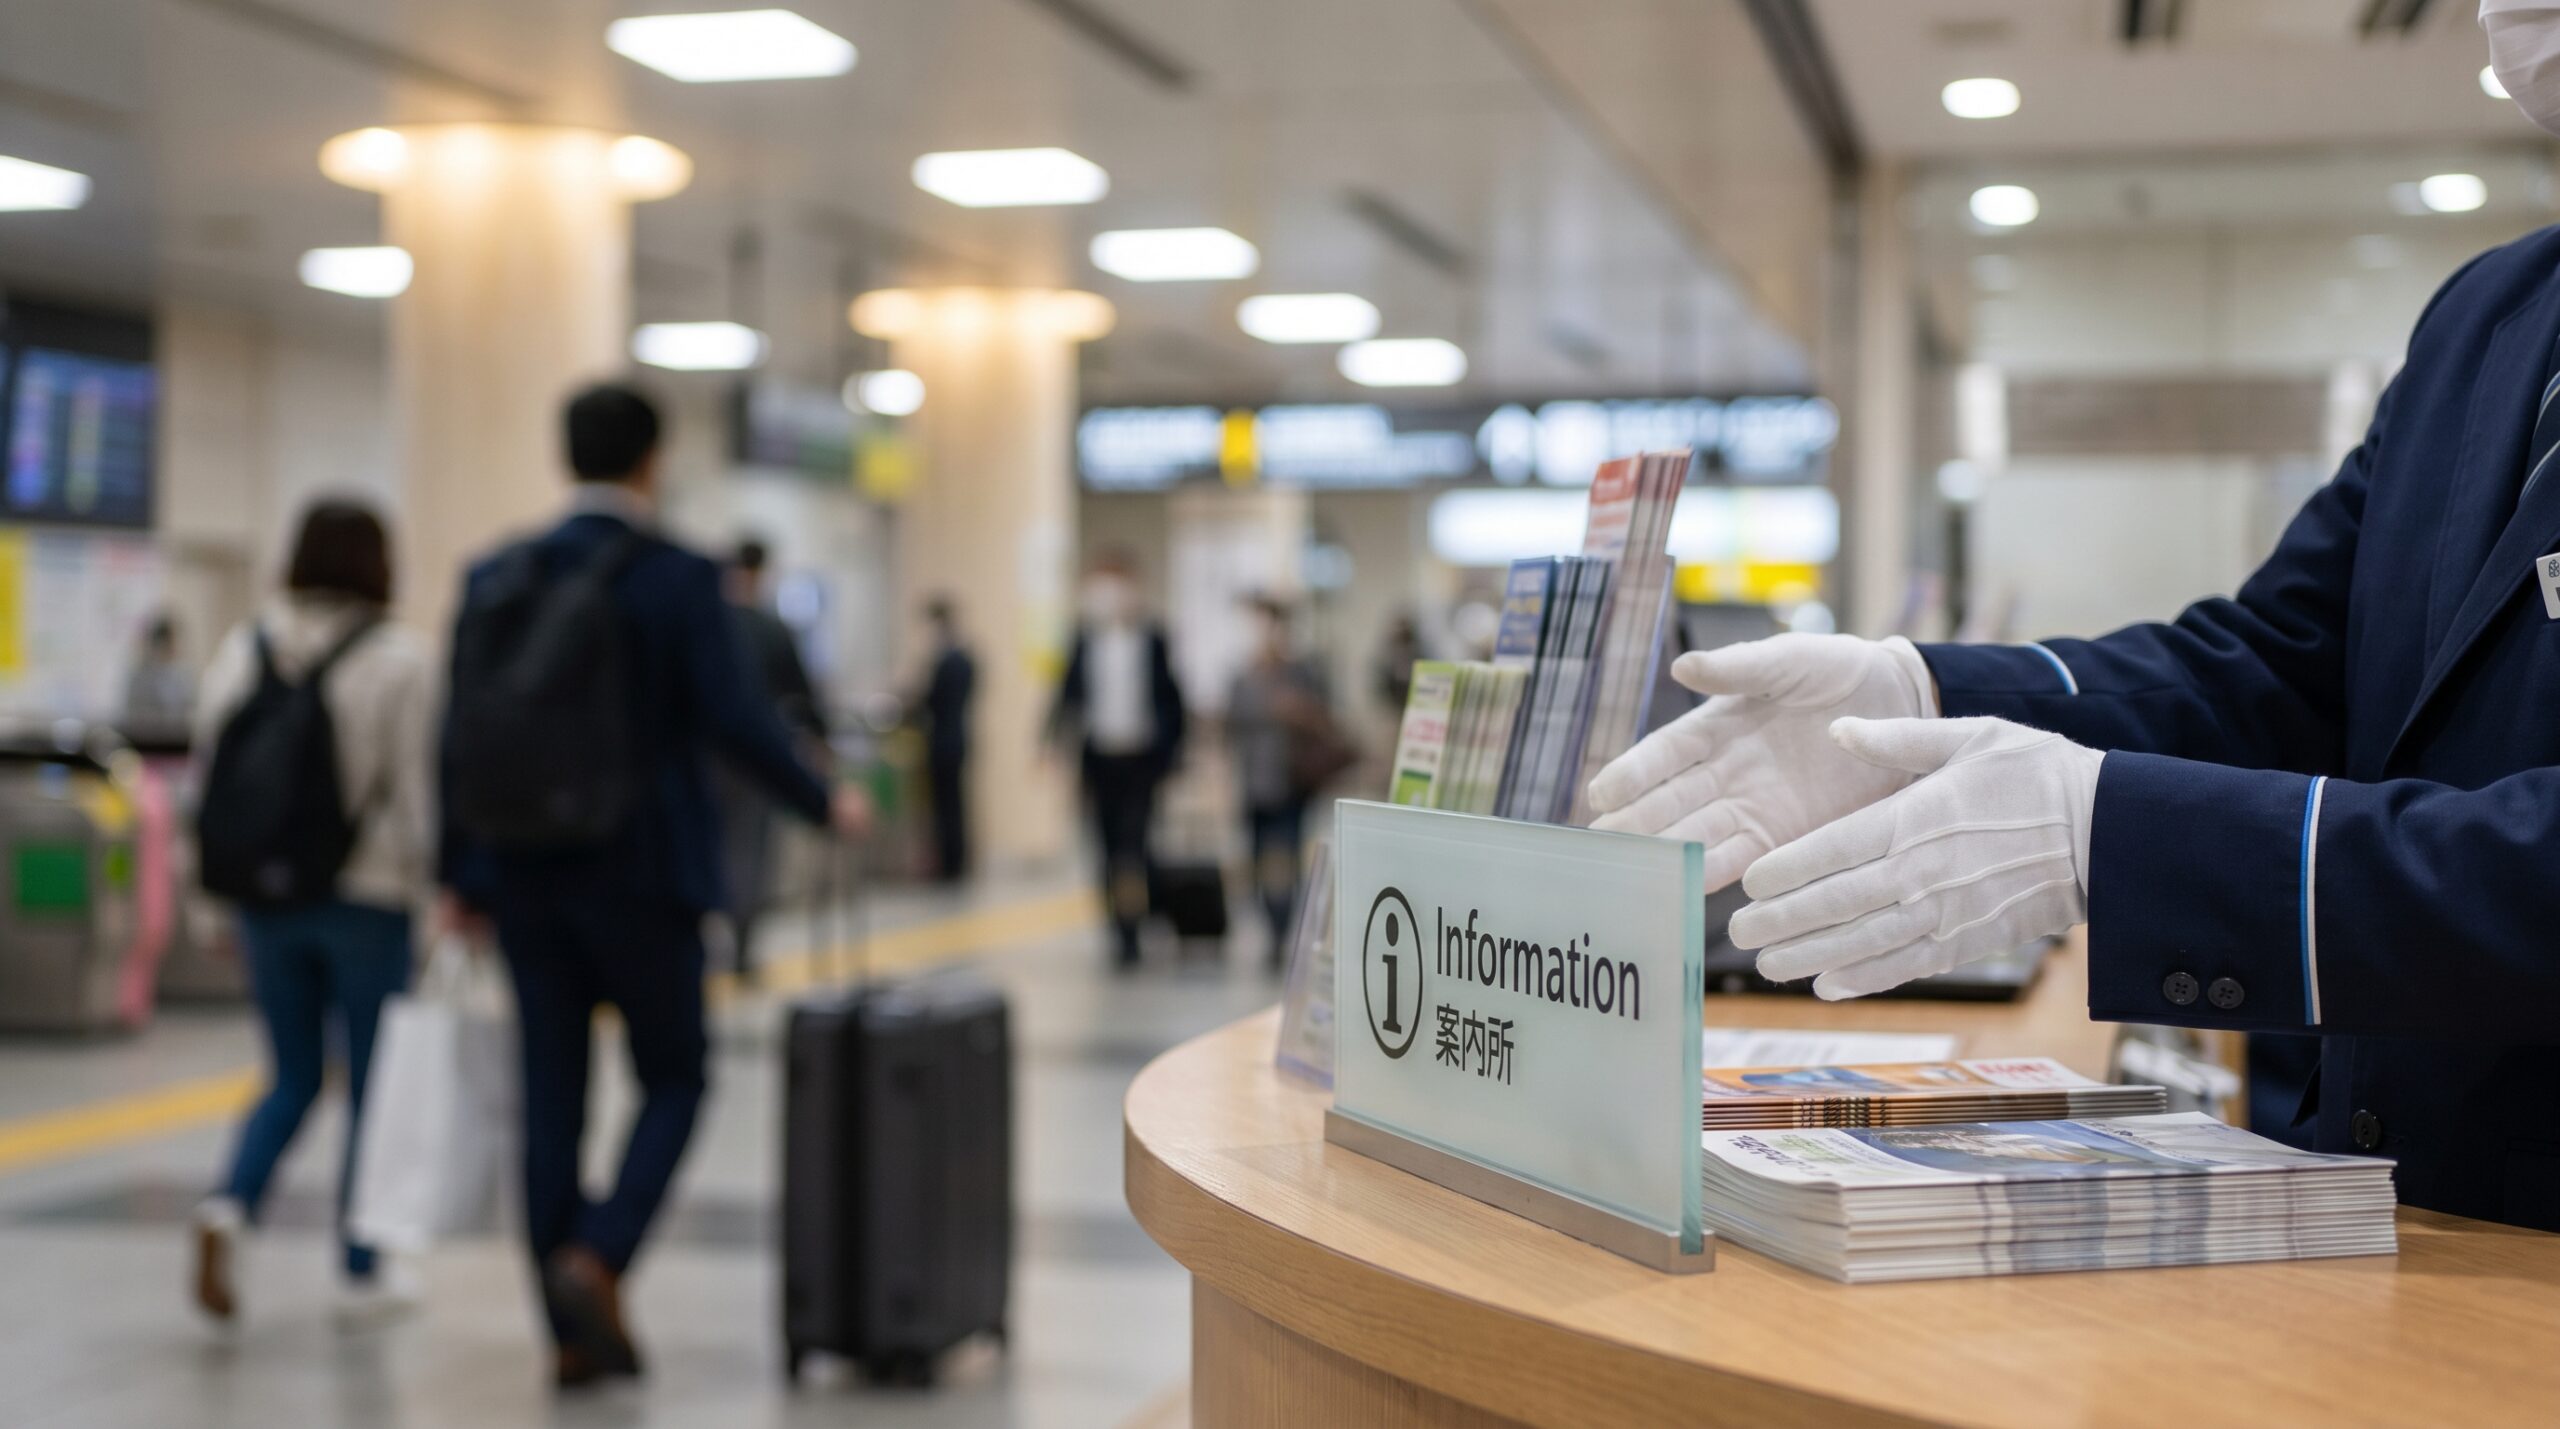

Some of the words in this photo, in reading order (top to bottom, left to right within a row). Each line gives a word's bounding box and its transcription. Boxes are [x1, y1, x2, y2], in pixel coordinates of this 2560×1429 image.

[1436, 906, 1640, 1021] Information
[1435, 1003, 1515, 1086] 案内所
